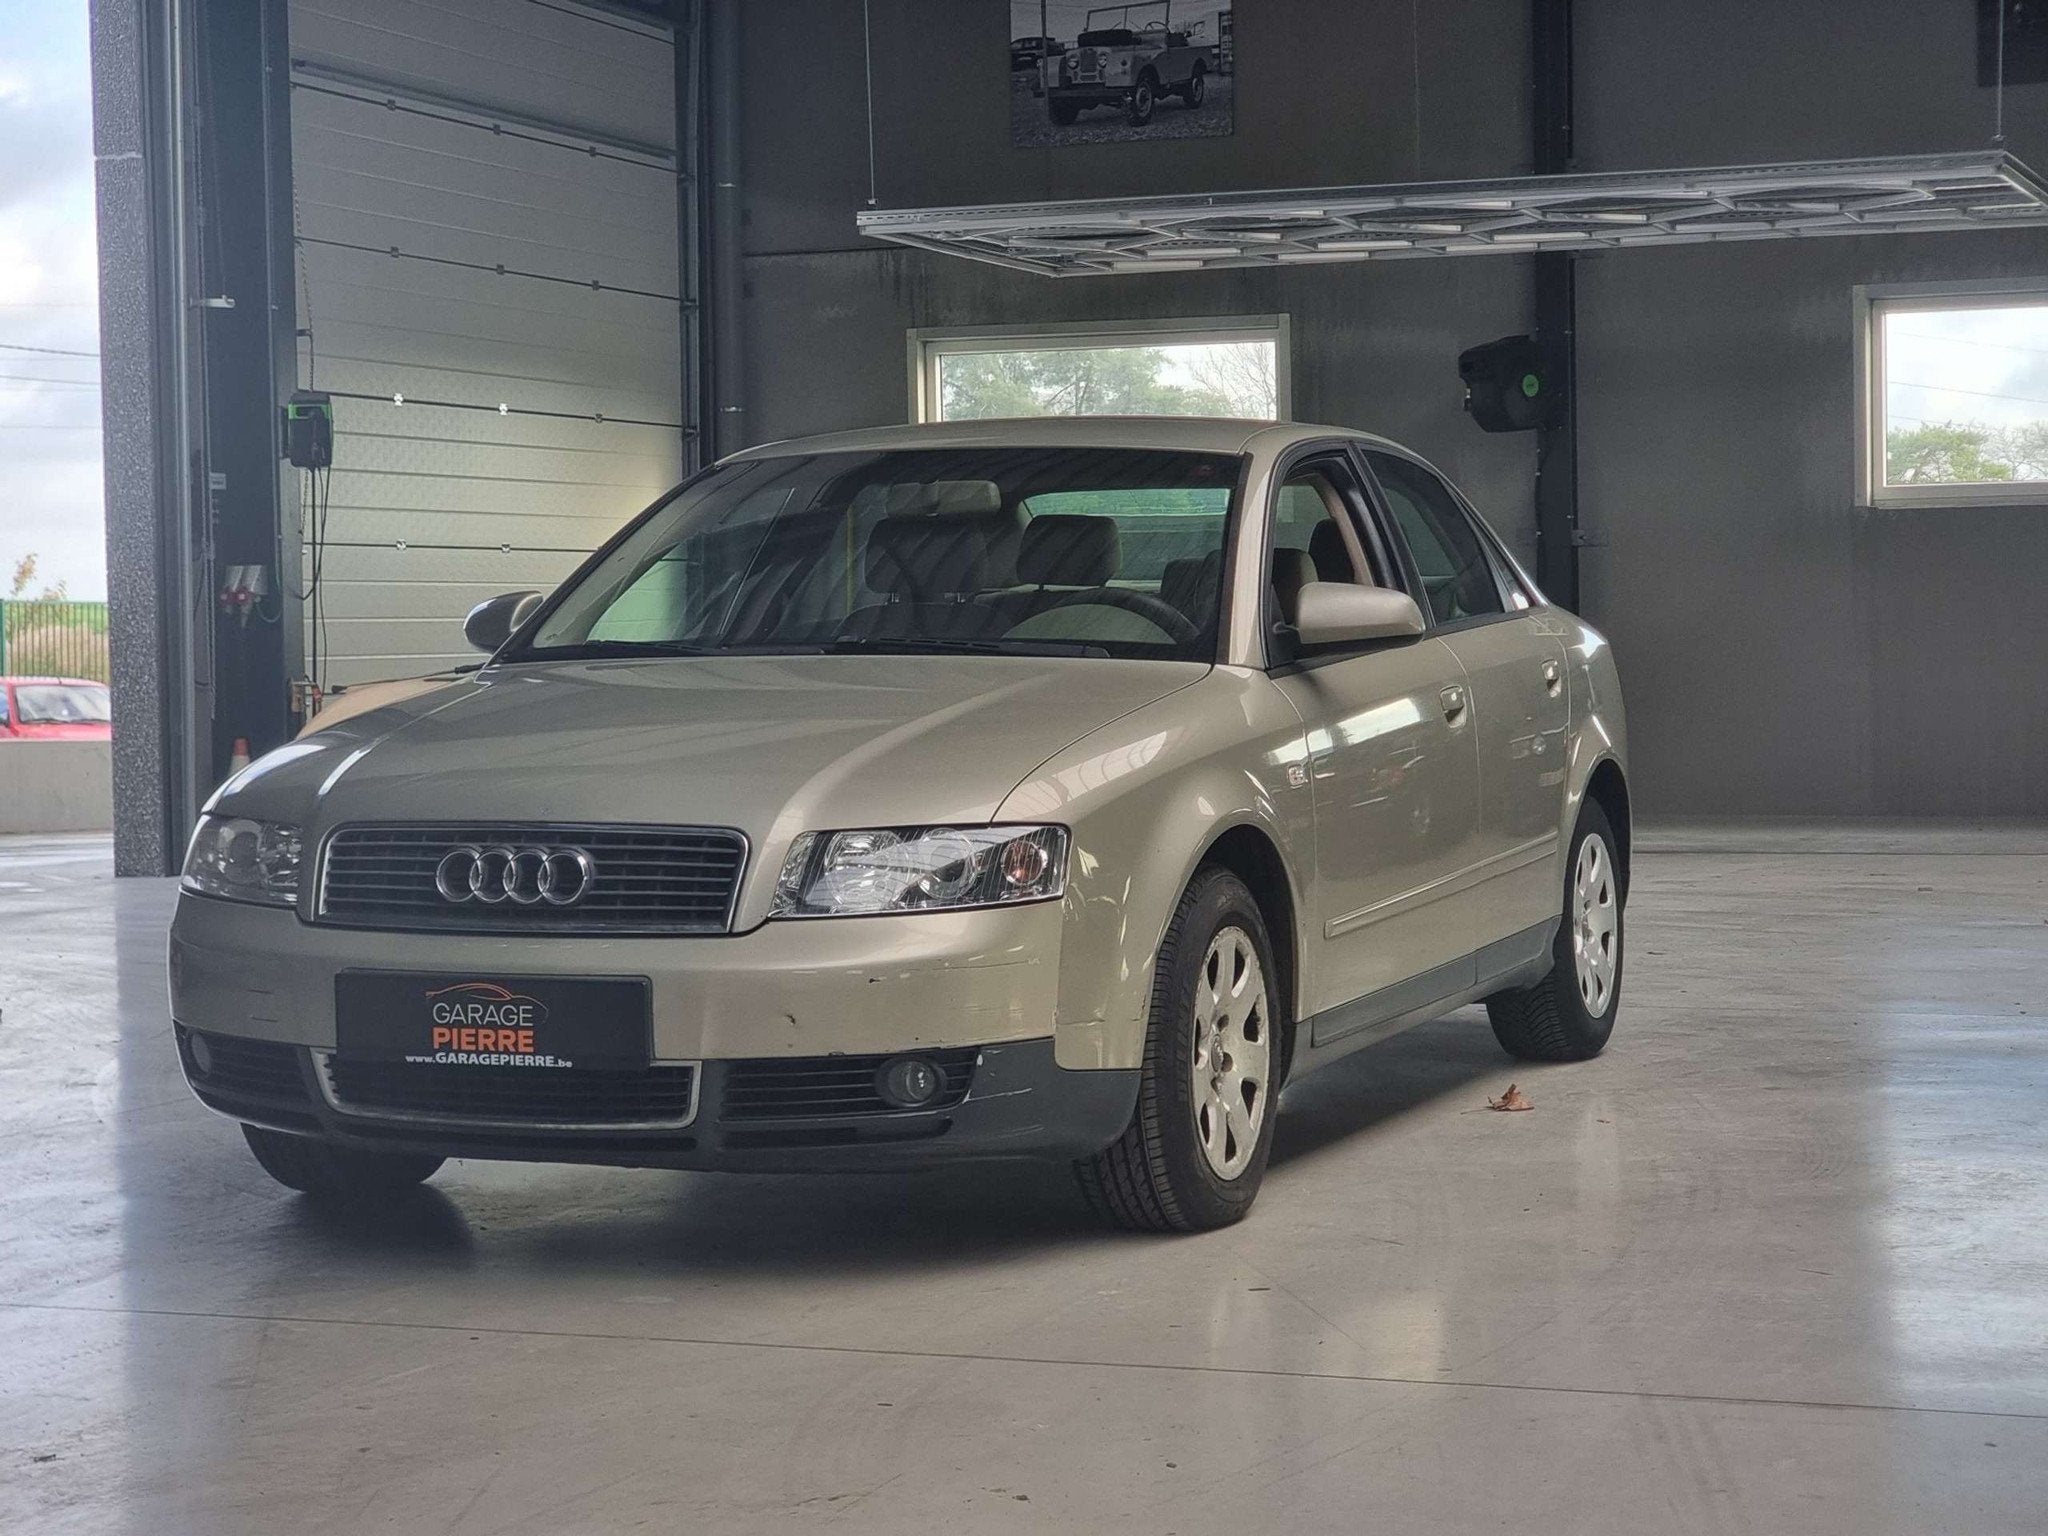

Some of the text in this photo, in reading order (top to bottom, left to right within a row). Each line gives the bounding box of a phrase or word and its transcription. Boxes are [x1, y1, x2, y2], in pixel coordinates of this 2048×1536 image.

[433, 1002, 533, 1026] GARAGE
[433, 1028, 534, 1052] PIERRE
[405, 1052, 573, 1068] www.GARAGEPIERRE.be
